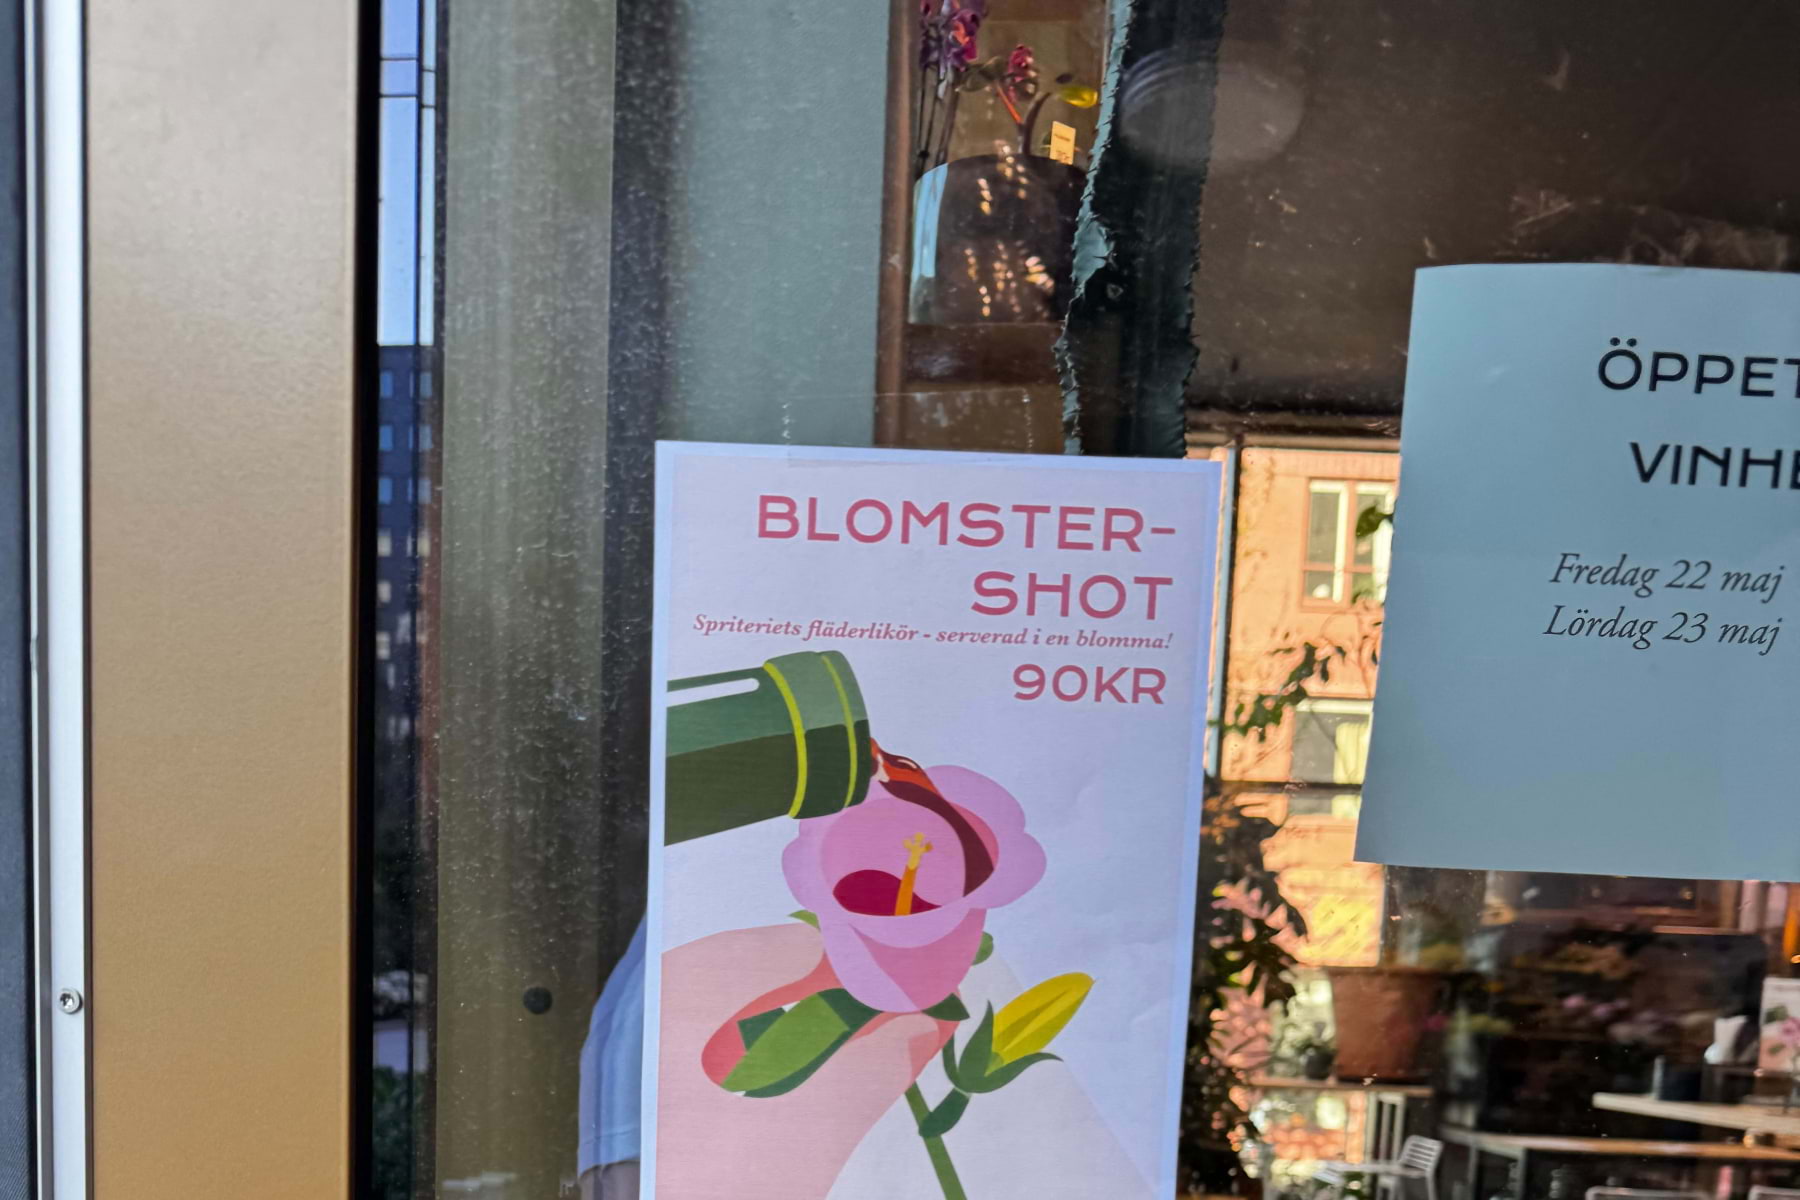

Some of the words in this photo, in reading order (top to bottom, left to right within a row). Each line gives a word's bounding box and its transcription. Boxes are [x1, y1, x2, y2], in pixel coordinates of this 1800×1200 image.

[1598, 337, 1800, 399] ÖPPET
[1629, 441, 1800, 489] VINH
[757, 494, 1176, 553] BLOMSTER-
[970, 571, 1174, 621] SHOT
[1549, 553, 1660, 598] Fredag
[1664, 559, 1712, 589] 22
[1720, 565, 1786, 604] maj
[693, 613, 802, 637] Spriteriets
[802, 620, 919, 642] fläderlikör
[935, 628, 1028, 646] serverad
[1032, 628, 1042, 646] i
[1045, 634, 1070, 647] en
[1076, 630, 1173, 650] blomma!
[1543, 605, 1658, 650] Lördag
[1662, 611, 1709, 643] 23
[1718, 617, 1783, 656] maj
[1012, 663, 1167, 705] 90KR
